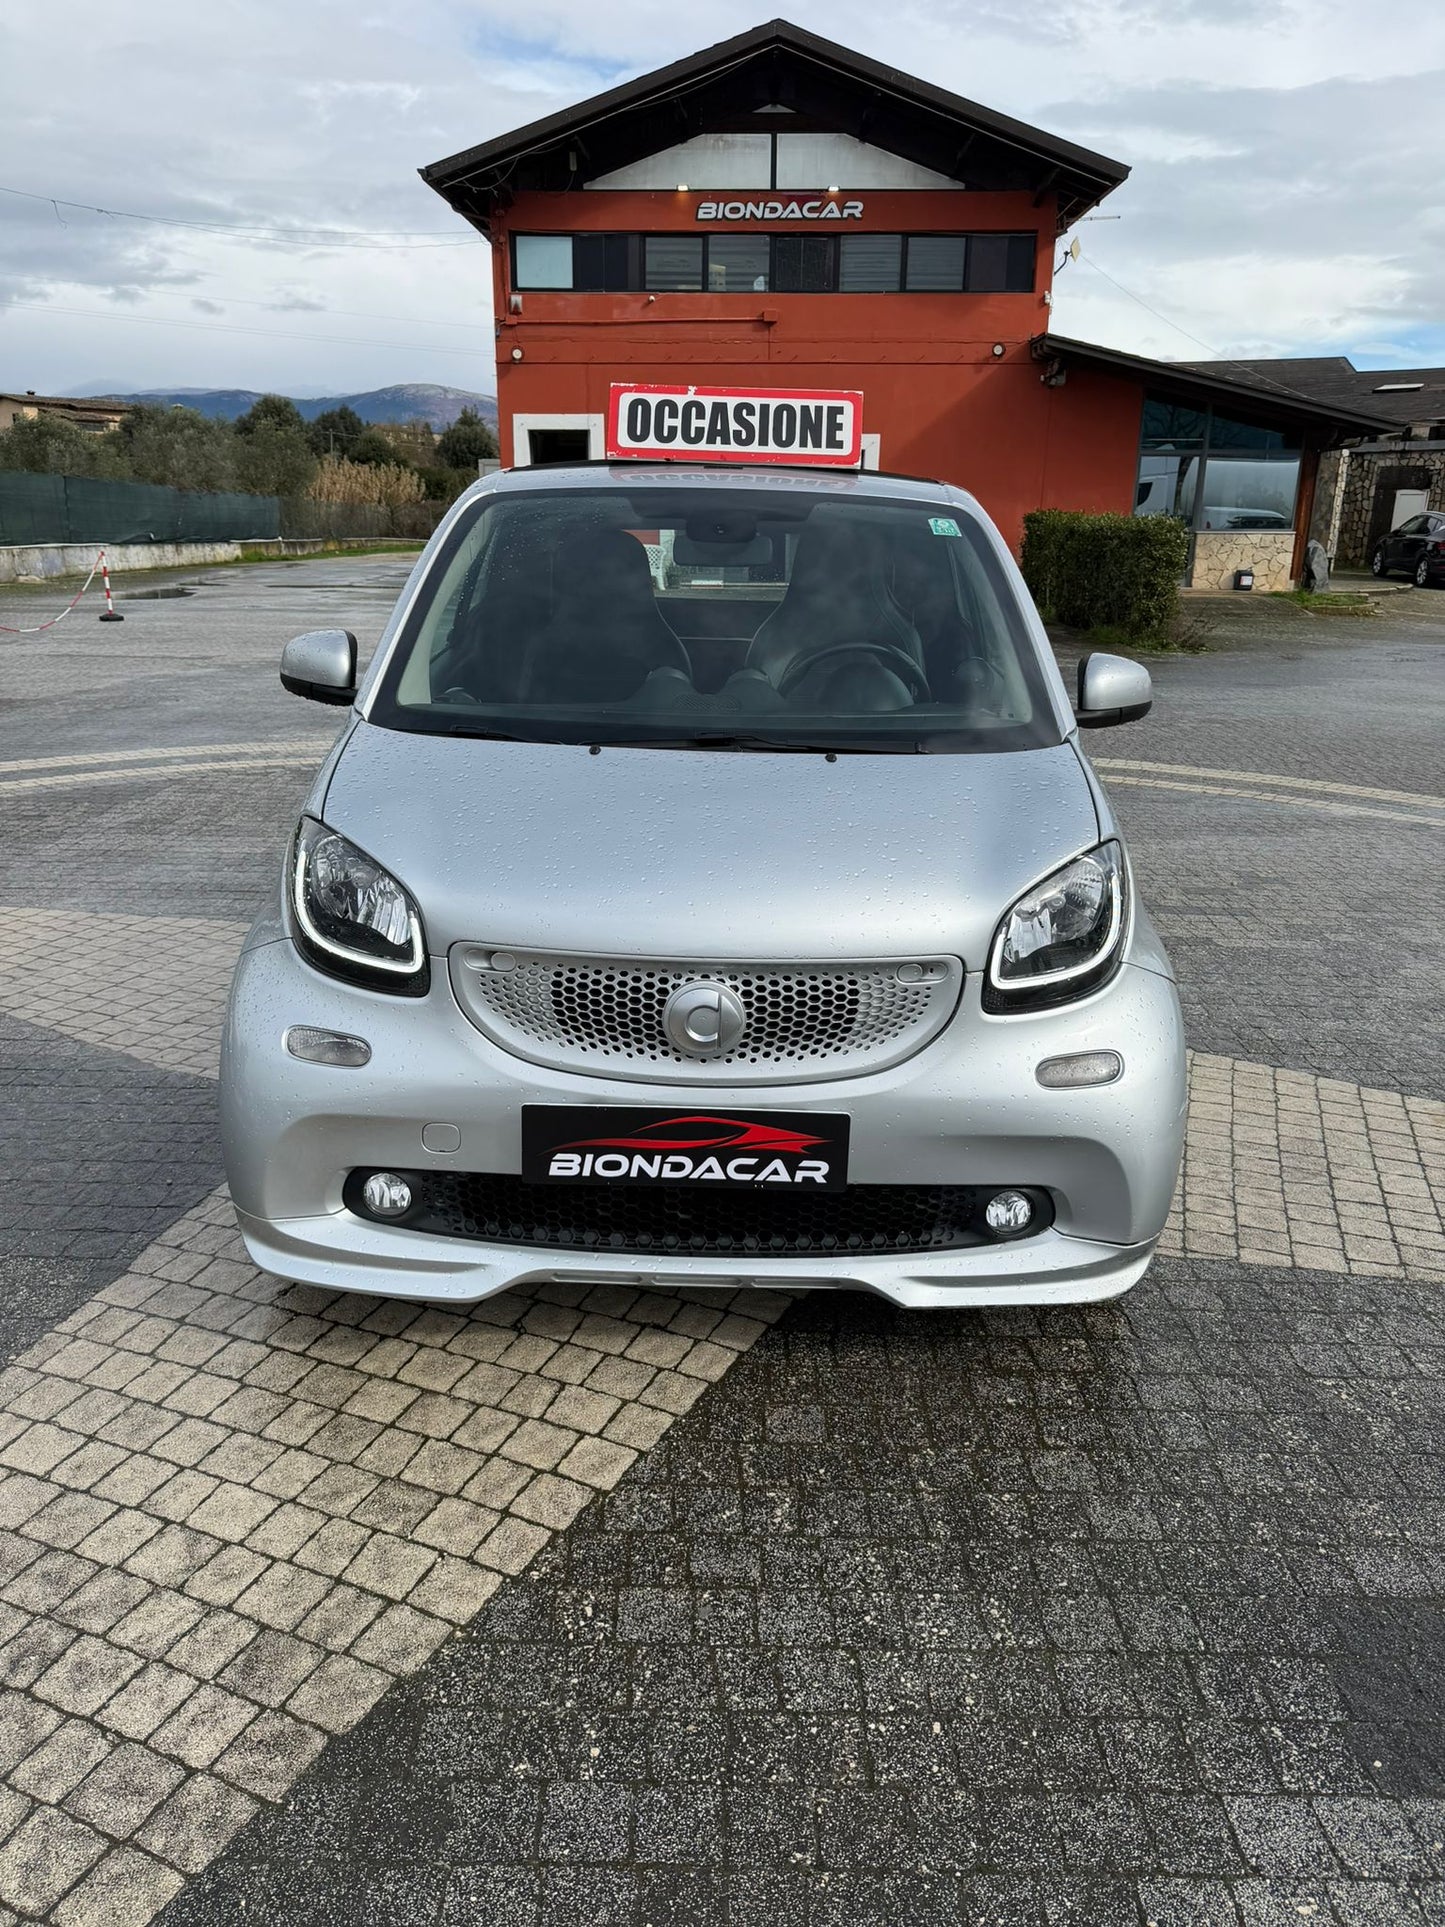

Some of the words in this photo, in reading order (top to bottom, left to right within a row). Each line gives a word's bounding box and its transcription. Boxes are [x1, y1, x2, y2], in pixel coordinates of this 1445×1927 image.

[697, 201, 864, 220] BIONDACAR
[627, 397, 844, 449] OCCASIONE
[549, 1153, 830, 1184] BIONDACAR
